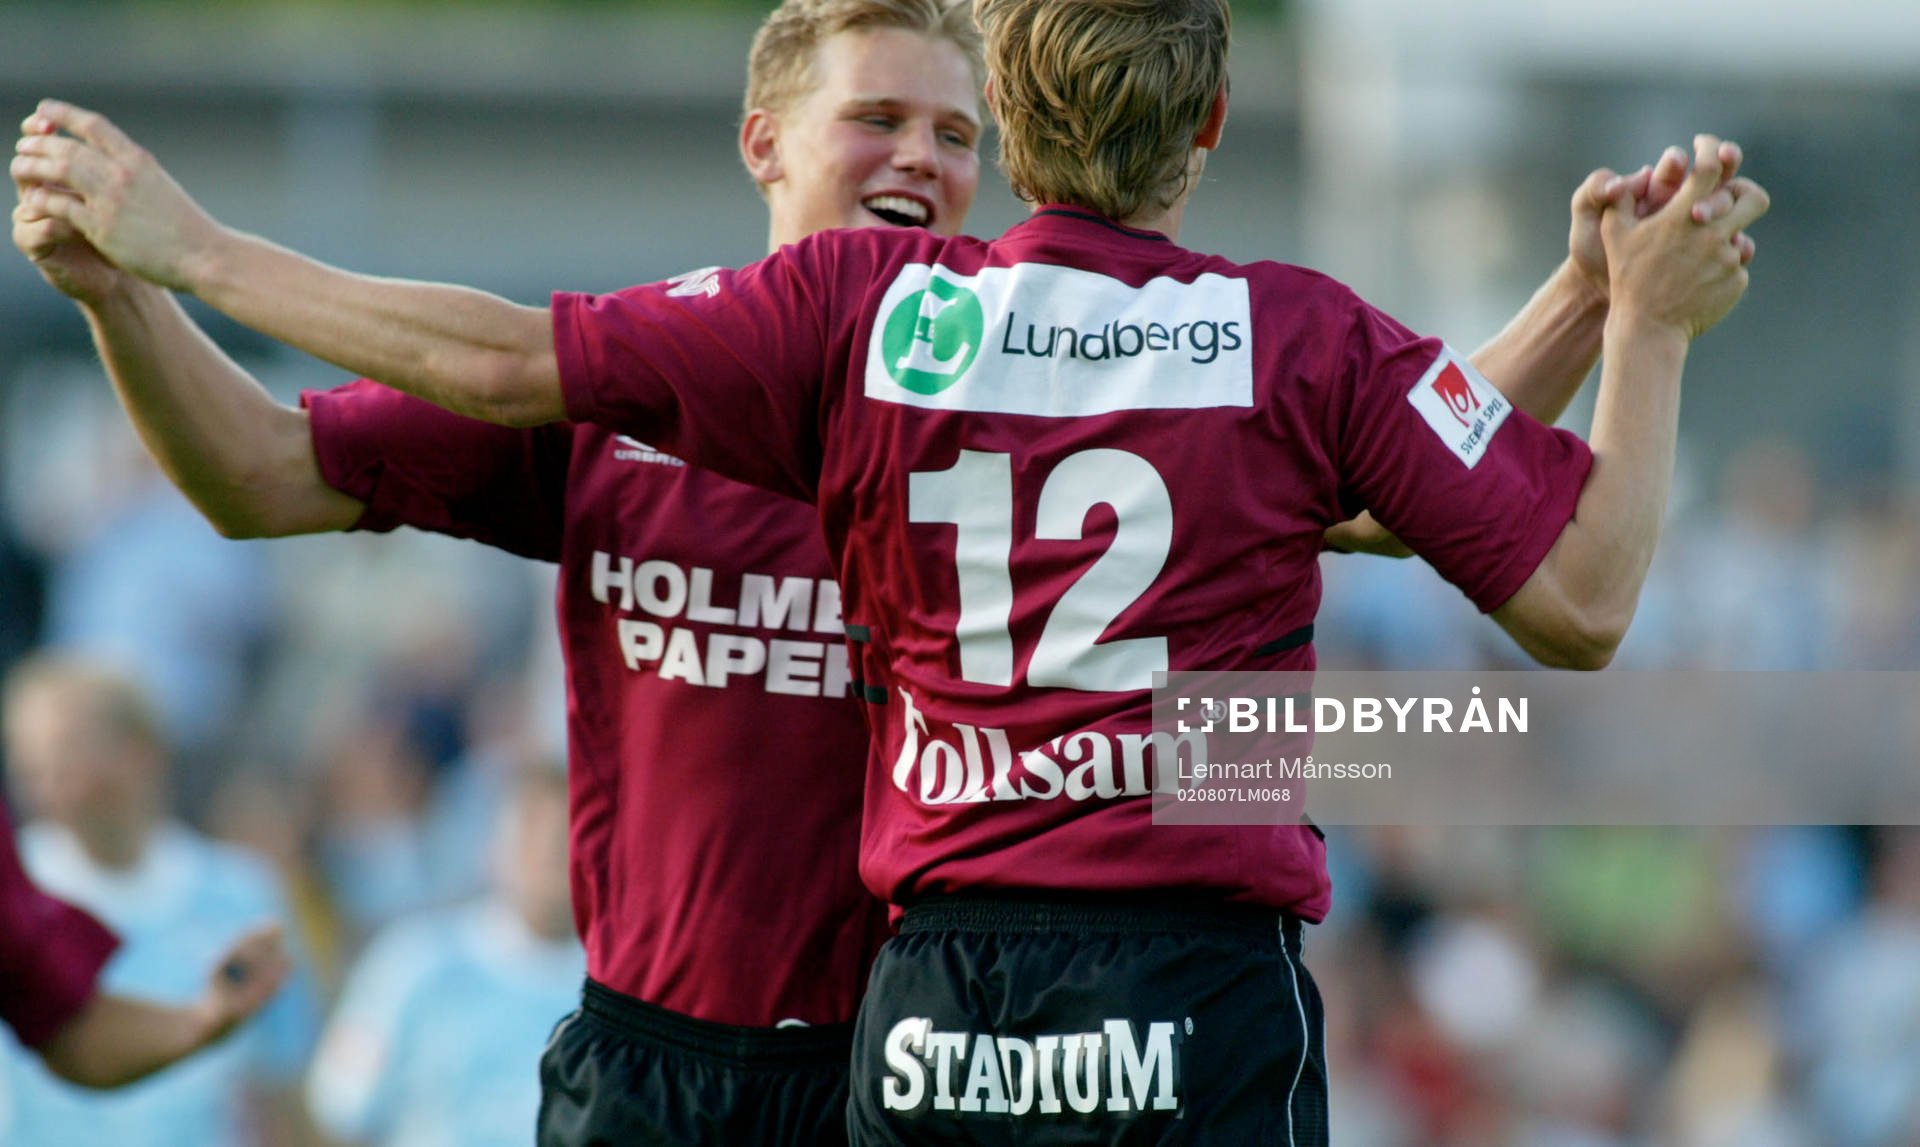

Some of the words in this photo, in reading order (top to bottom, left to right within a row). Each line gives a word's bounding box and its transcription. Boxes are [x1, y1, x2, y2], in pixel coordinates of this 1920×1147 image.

[1001, 311, 1243, 364] Lundbergs
[1460, 418, 1486, 455] SVEA
[908, 448, 1174, 692] 12
[882, 1016, 1179, 1116] STADIUM
